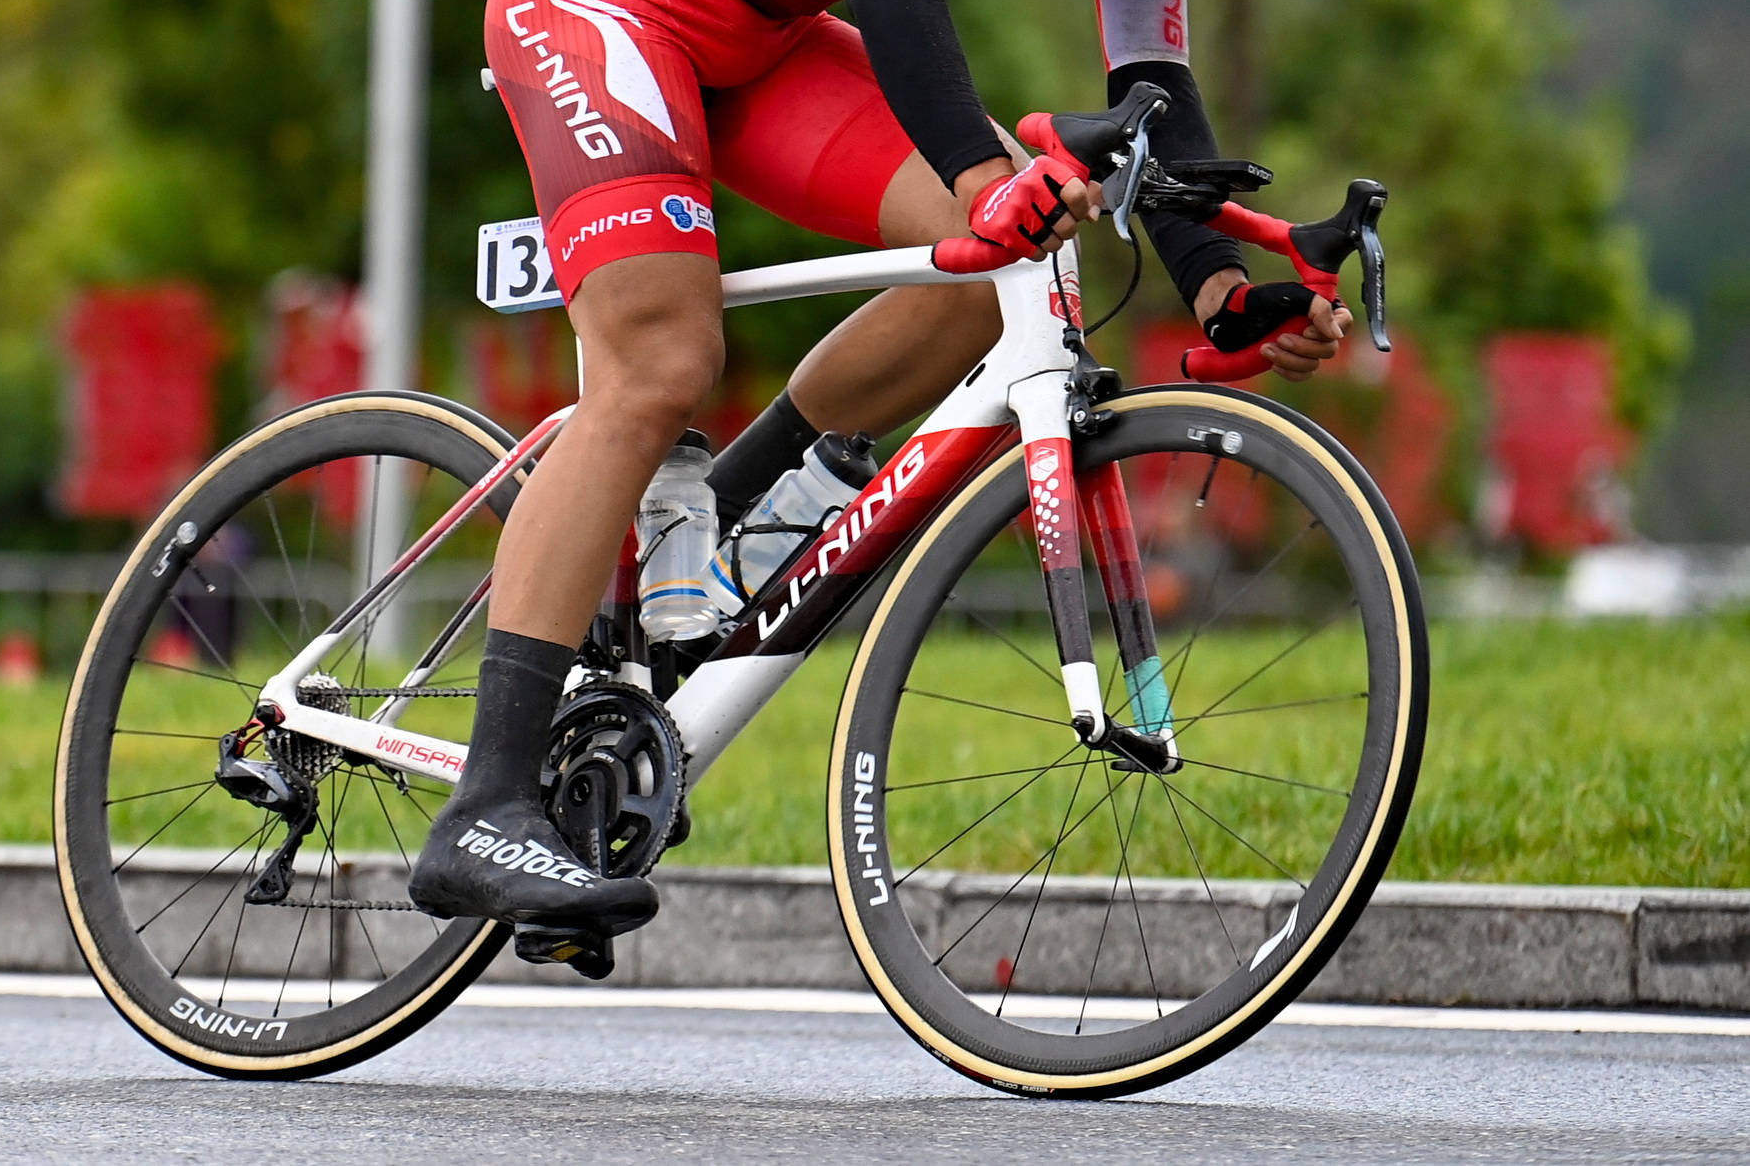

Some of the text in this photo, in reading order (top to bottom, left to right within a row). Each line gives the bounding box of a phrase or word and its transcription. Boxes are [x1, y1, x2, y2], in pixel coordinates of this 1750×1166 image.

[505, 0, 624, 161] LI-NING
[561, 207, 654, 263] LI-NING
[757, 441, 927, 642] LI-NING
[854, 751, 890, 907] LI-NING
[169, 997, 290, 1042] LI-NING
